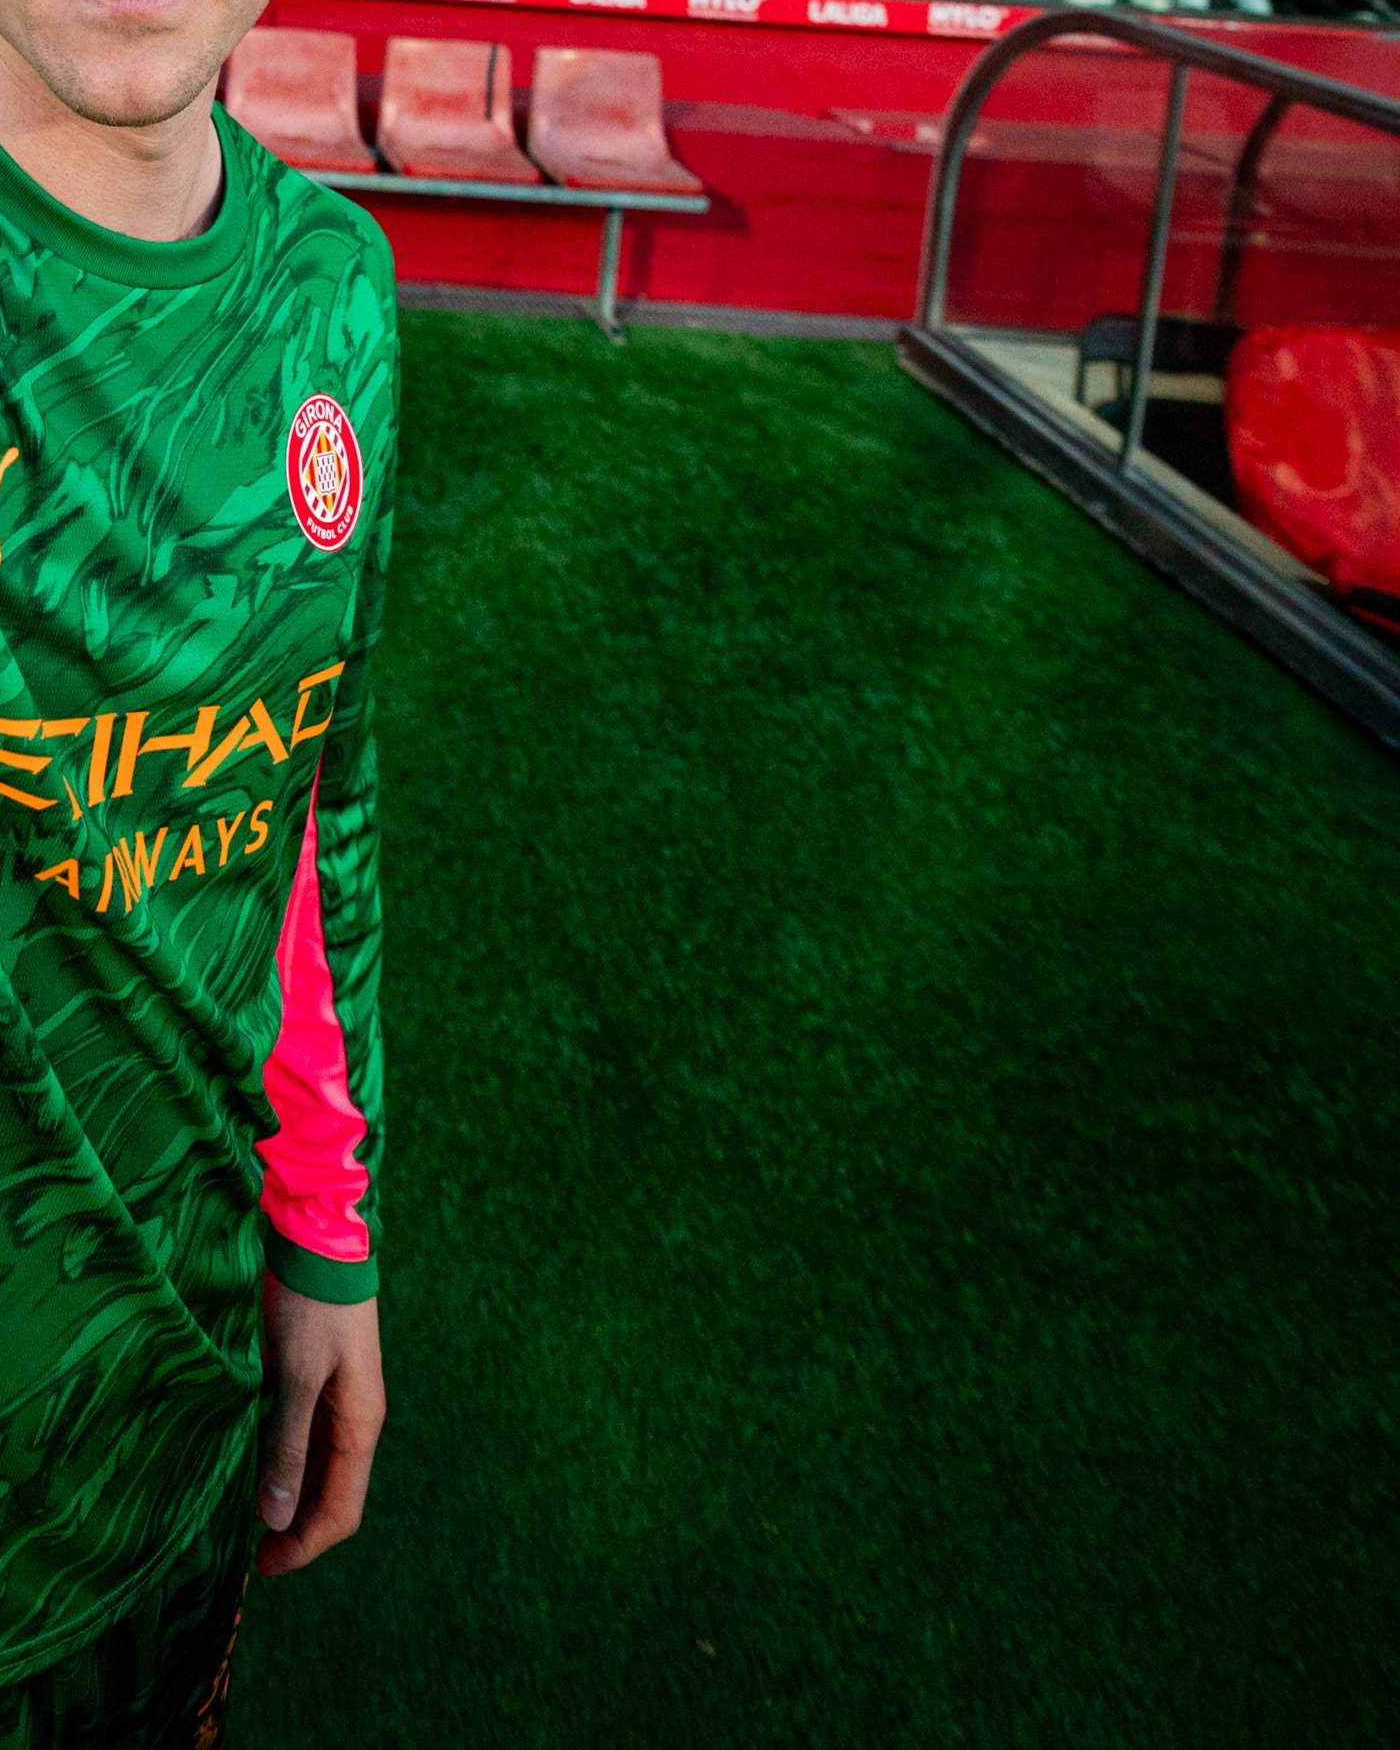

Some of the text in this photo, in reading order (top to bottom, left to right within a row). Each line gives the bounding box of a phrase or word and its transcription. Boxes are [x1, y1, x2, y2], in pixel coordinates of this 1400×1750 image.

[295, 401, 343, 439] GIRONA
[306, 504, 354, 540] FUTBOL CLUB
[34, 800, 273, 914] AIWAYS
